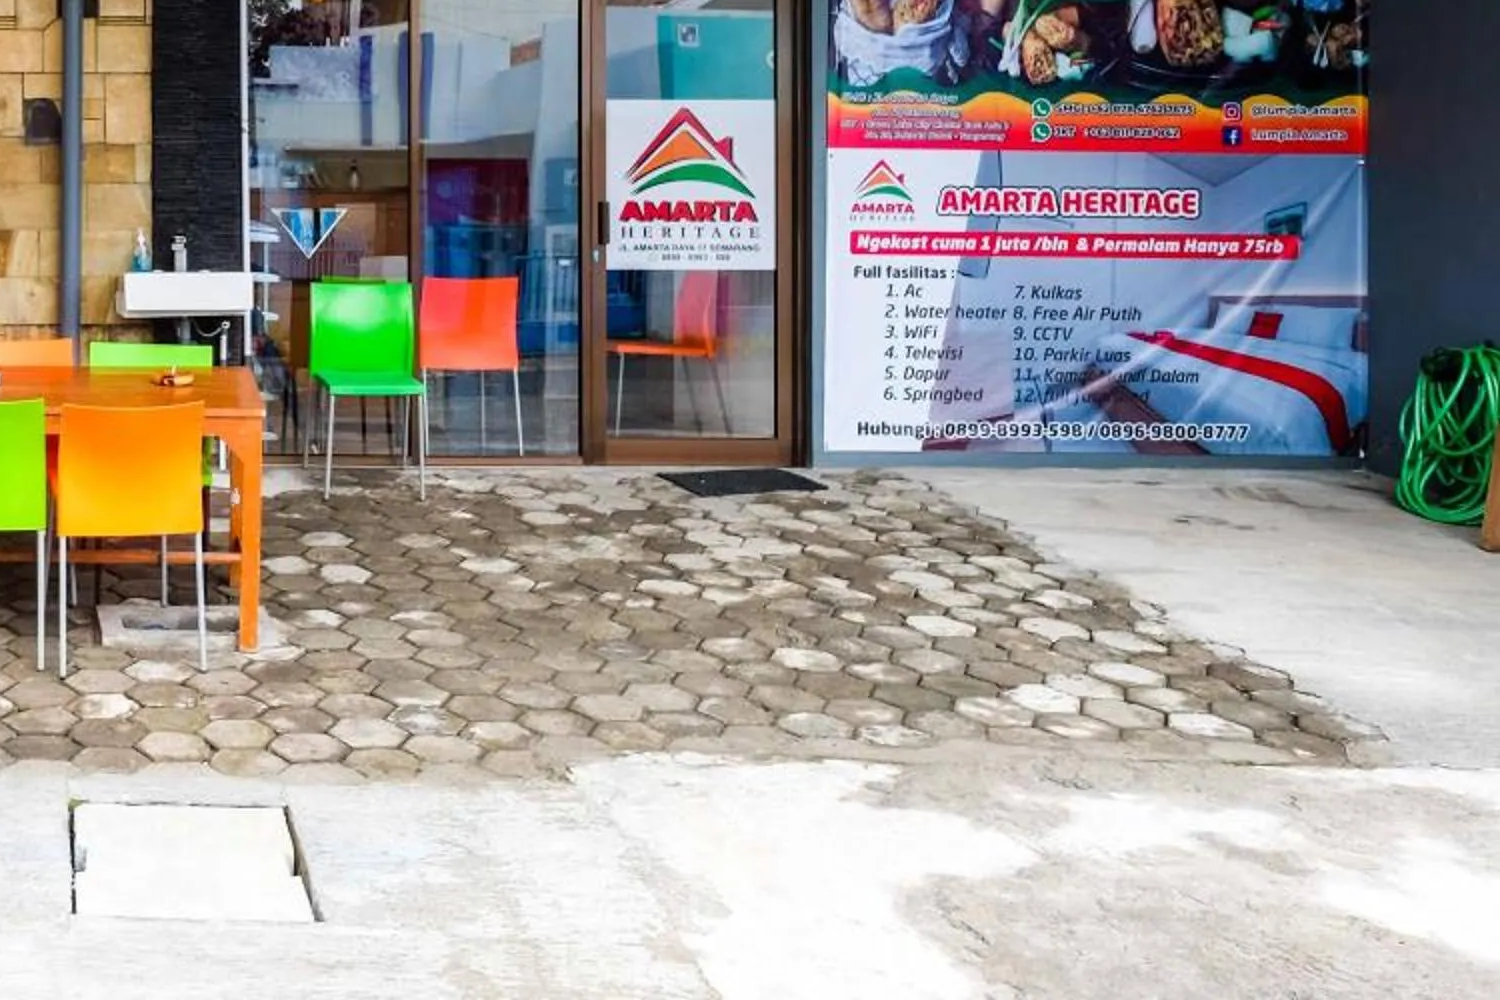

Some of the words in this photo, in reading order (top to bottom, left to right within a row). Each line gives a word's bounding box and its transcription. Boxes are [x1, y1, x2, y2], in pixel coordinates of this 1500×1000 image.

[851, 203, 915, 214] AMARTA
[938, 188, 1060, 215] AMARTA
[1061, 189, 1199, 217] HERITAGE
[619, 200, 759, 222] AMARTA
[620, 226, 760, 239] HERITAGE
[857, 233, 928, 254] Ngekost
[931, 237, 976, 250] cuma
[980, 237, 991, 250] 1
[1076, 237, 1088, 251] &
[1092, 237, 1180, 253] Permalam
[1183, 239, 1239, 256] Hanya
[1243, 239, 1284, 254] 75rb
[854, 266, 882, 279] Full
[885, 266, 947, 279] fasilitas
[886, 284, 899, 298] 1.
[904, 284, 923, 298] Ac
[1014, 285, 1025, 300] 7.
[1031, 285, 1083, 300] Kulkas
[884, 304, 899, 319] 2.
[905, 305, 951, 319] Water
[955, 305, 1007, 319] heater
[1013, 305, 1027, 320] 8.
[1033, 306, 1069, 321] Free
[1072, 306, 1096, 321] Air
[1100, 307, 1142, 321] Putih
[884, 325, 898, 339] 3.
[905, 325, 938, 339] WiFi
[1013, 326, 1027, 341] 9.
[1033, 327, 1074, 341] CCTV
[884, 346, 898, 360] 4.
[905, 346, 964, 360] Televisi
[1013, 347, 1038, 361] 10.
[1043, 347, 1093, 362] Parkir
[1095, 348, 1132, 362] Luas
[884, 365, 898, 380] 5.
[904, 366, 951, 382] Dapur
[1150, 369, 1200, 383] Dalam
[883, 386, 897, 400] 6.
[903, 387, 984, 404] Springbed
[857, 421, 931, 439] Hubungi
[1100, 423, 1249, 440] 0896-9800-8777
